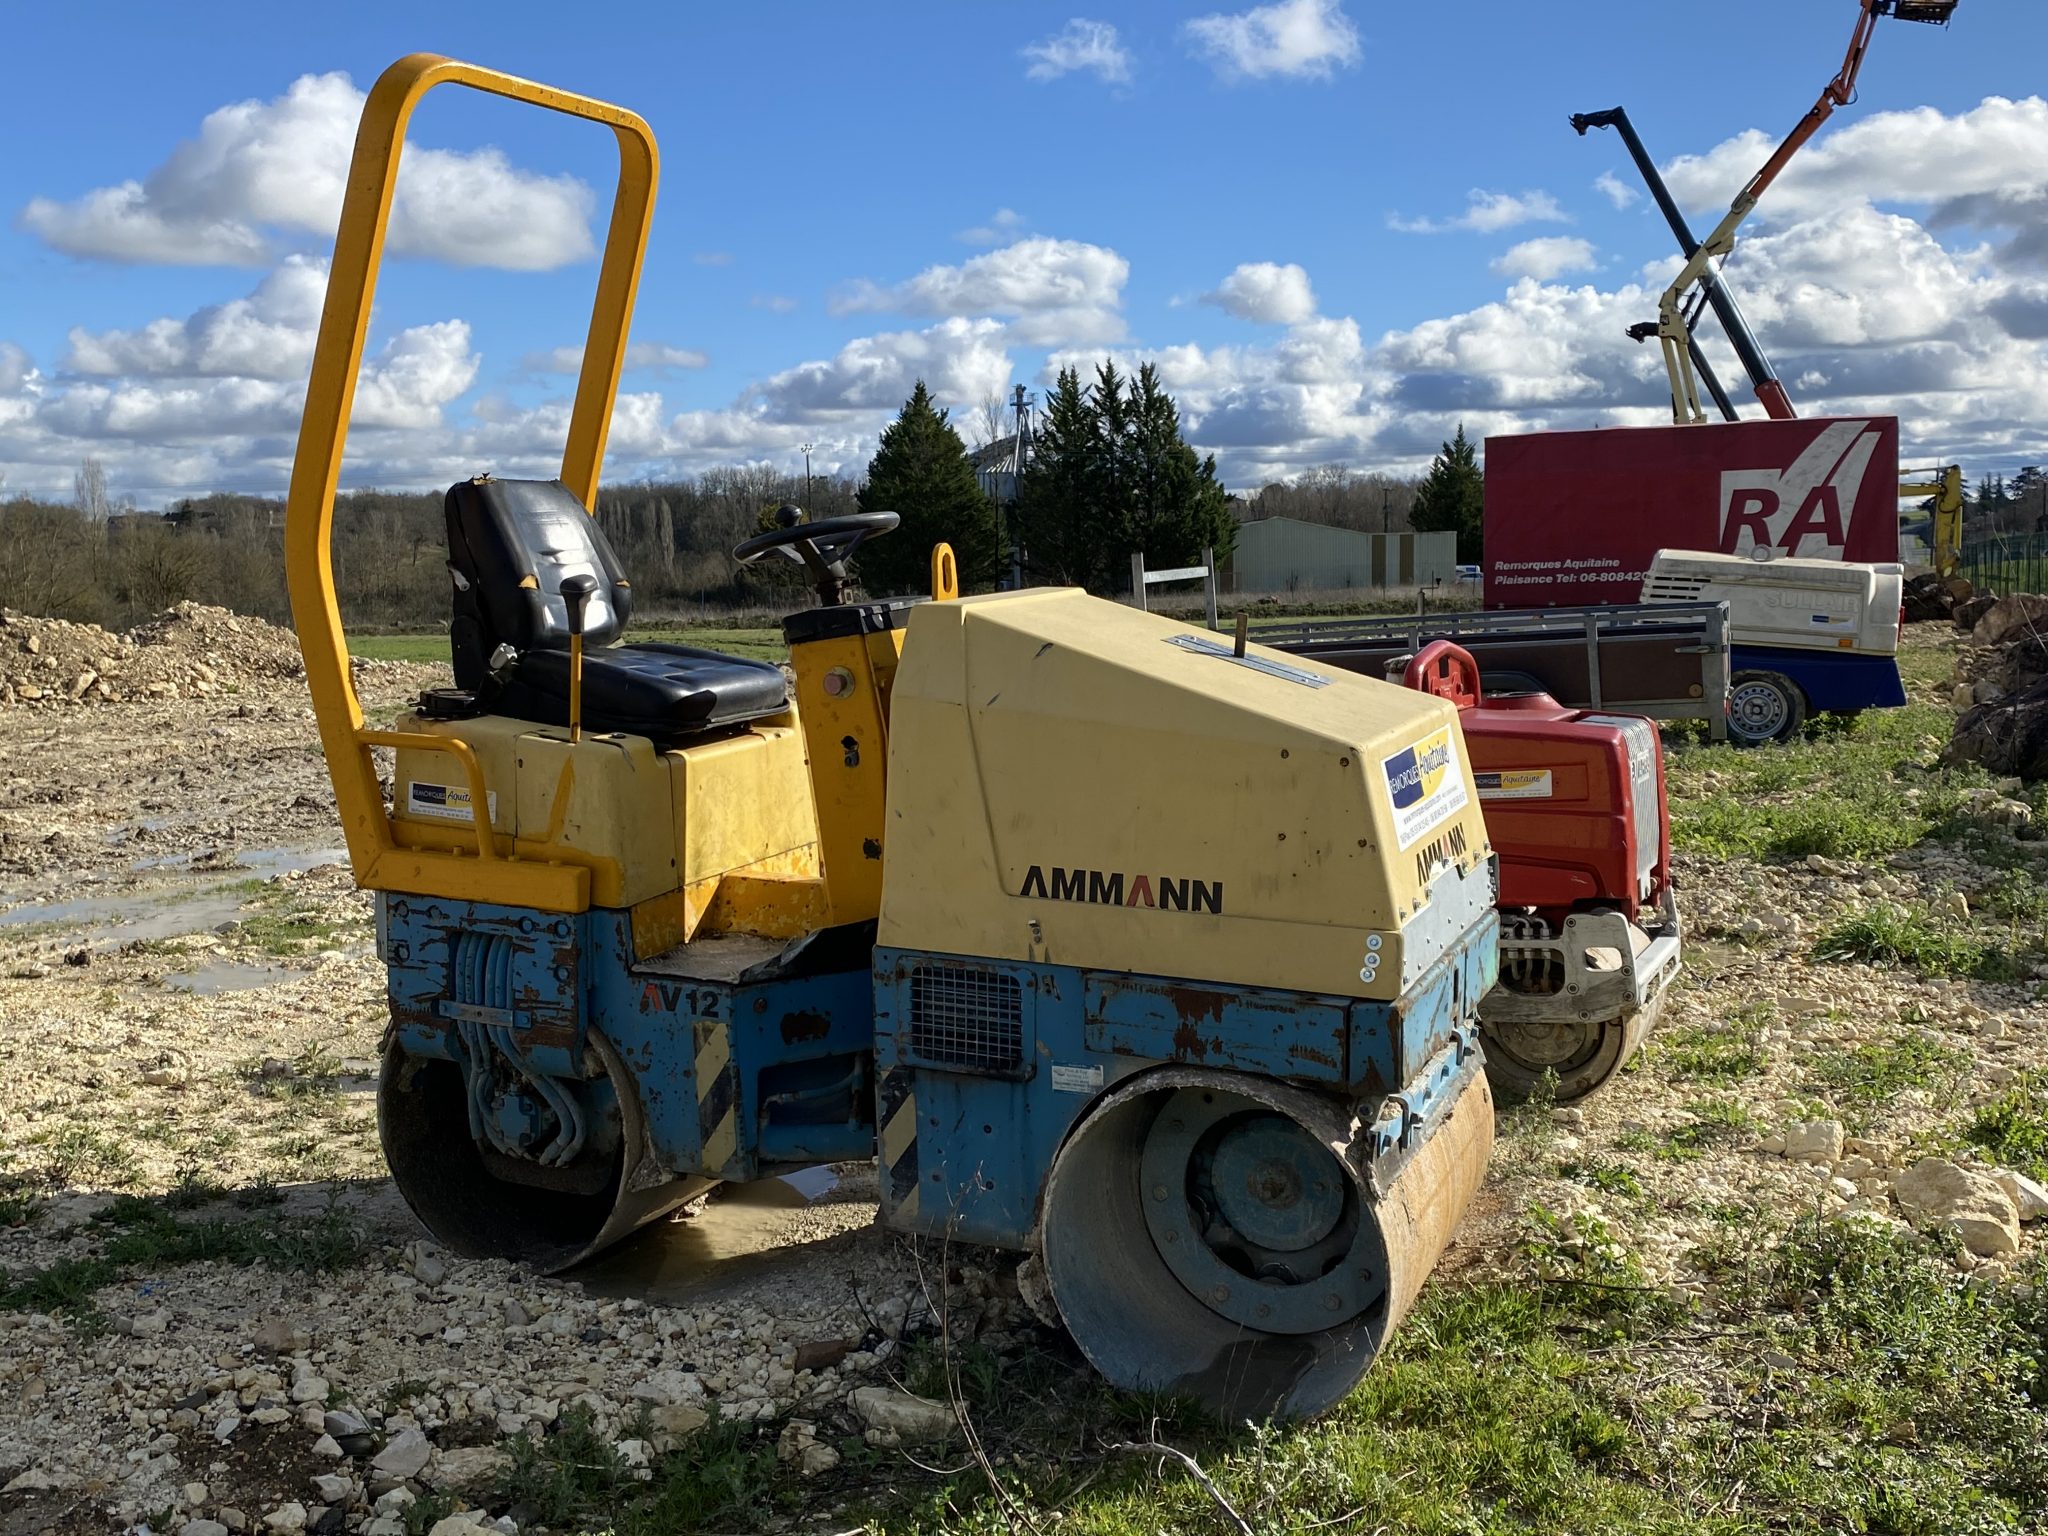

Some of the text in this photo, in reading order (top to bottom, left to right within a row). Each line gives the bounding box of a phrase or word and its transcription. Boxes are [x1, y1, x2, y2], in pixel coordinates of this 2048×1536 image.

[1721, 486, 1846, 557] RA
[1495, 558, 1620, 571] Remorques Aquitaine
[1495, 574, 1553, 585] Plaisance
[1556, 573, 1577, 583] Tel:
[1765, 590, 1859, 612] SULLAIR
[1389, 765, 1421, 795] REMORQUES
[1416, 822, 1467, 887] AMMANN
[1020, 865, 1223, 914] AMMANN
[640, 983, 719, 1018] AV 12
